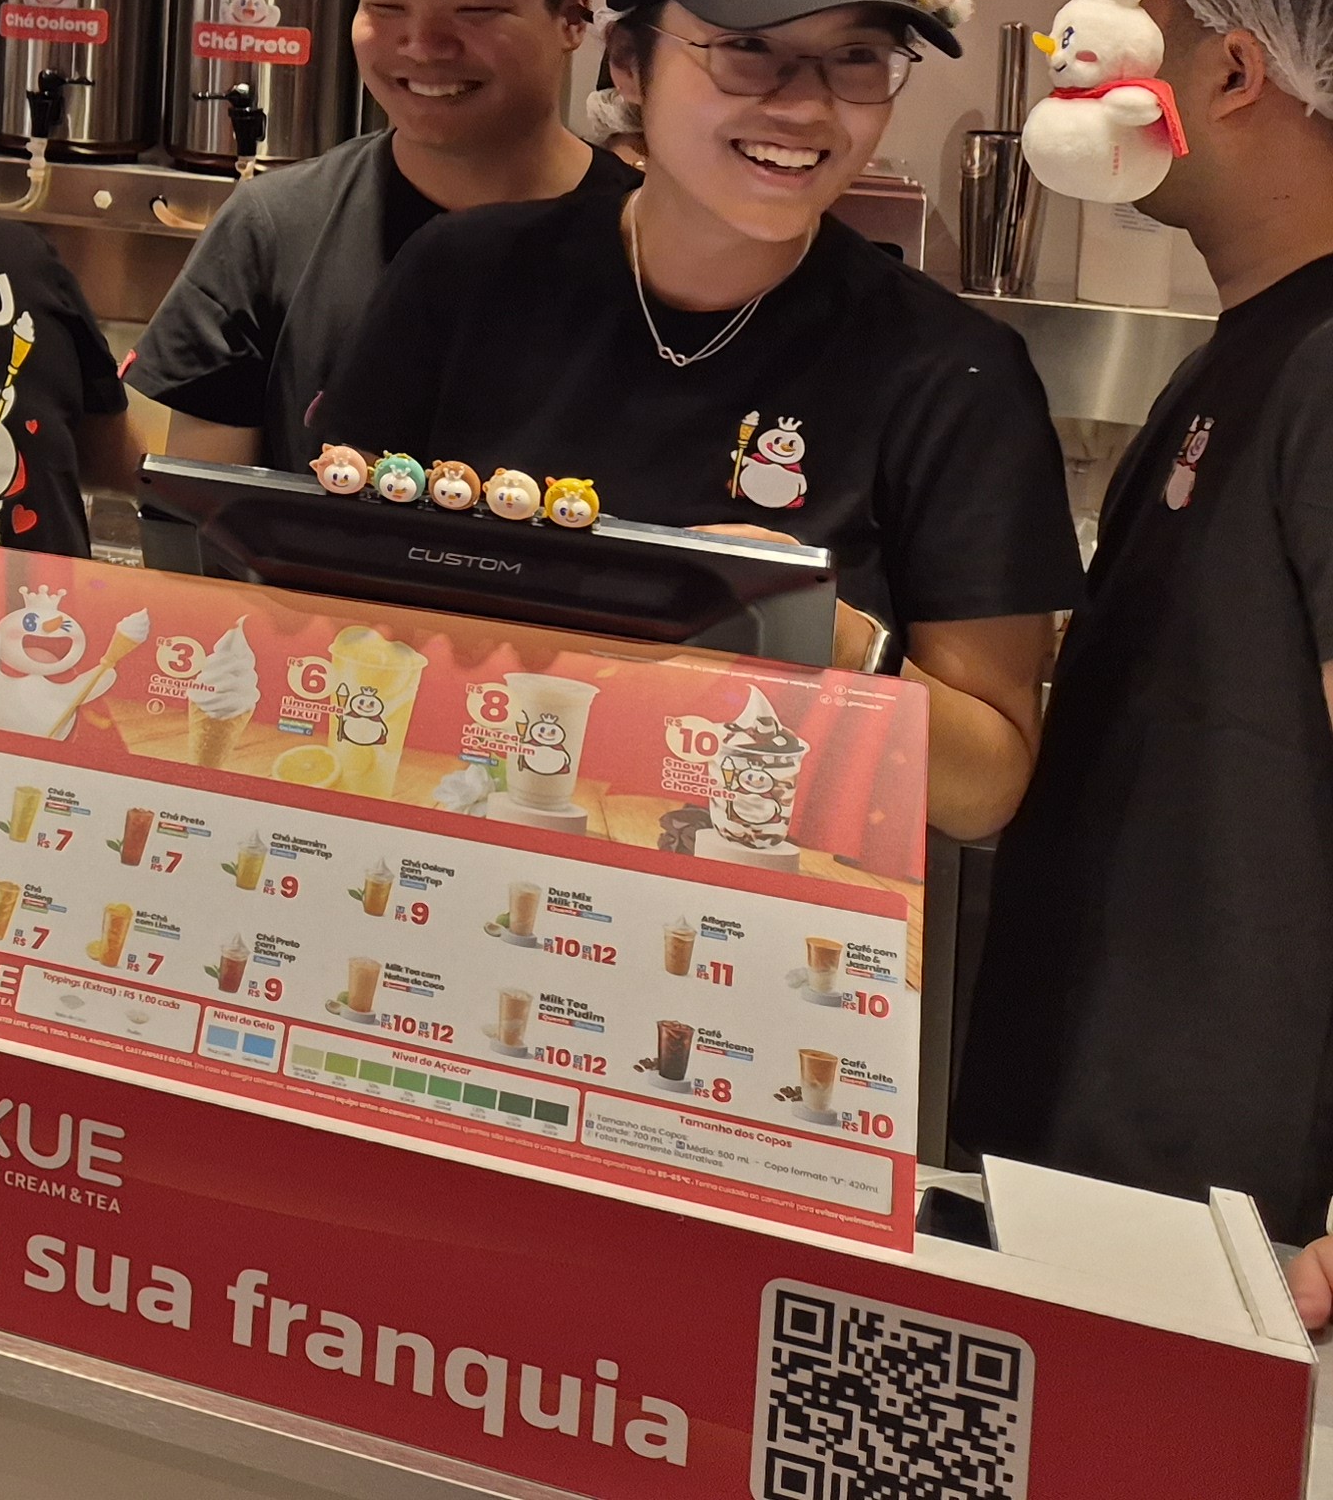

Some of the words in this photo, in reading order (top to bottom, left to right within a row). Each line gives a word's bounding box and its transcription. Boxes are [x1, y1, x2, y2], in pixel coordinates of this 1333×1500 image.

[5, 10, 34, 30] Chá
[36, 15, 99, 38] Oolong
[198, 29, 238, 50] Chá
[240, 33, 301, 56] Preto
[408, 546, 522, 575] CUSTOM
[168, 643, 195, 672] 3
[151, 675, 215, 692] Casquinha
[301, 663, 327, 694] 6
[282, 697, 344, 714] Limonada
[480, 690, 509, 722] 8
[679, 729, 719, 756] 10
[23, 1234, 193, 1330] sua
[226, 1268, 689, 1467] franquia
